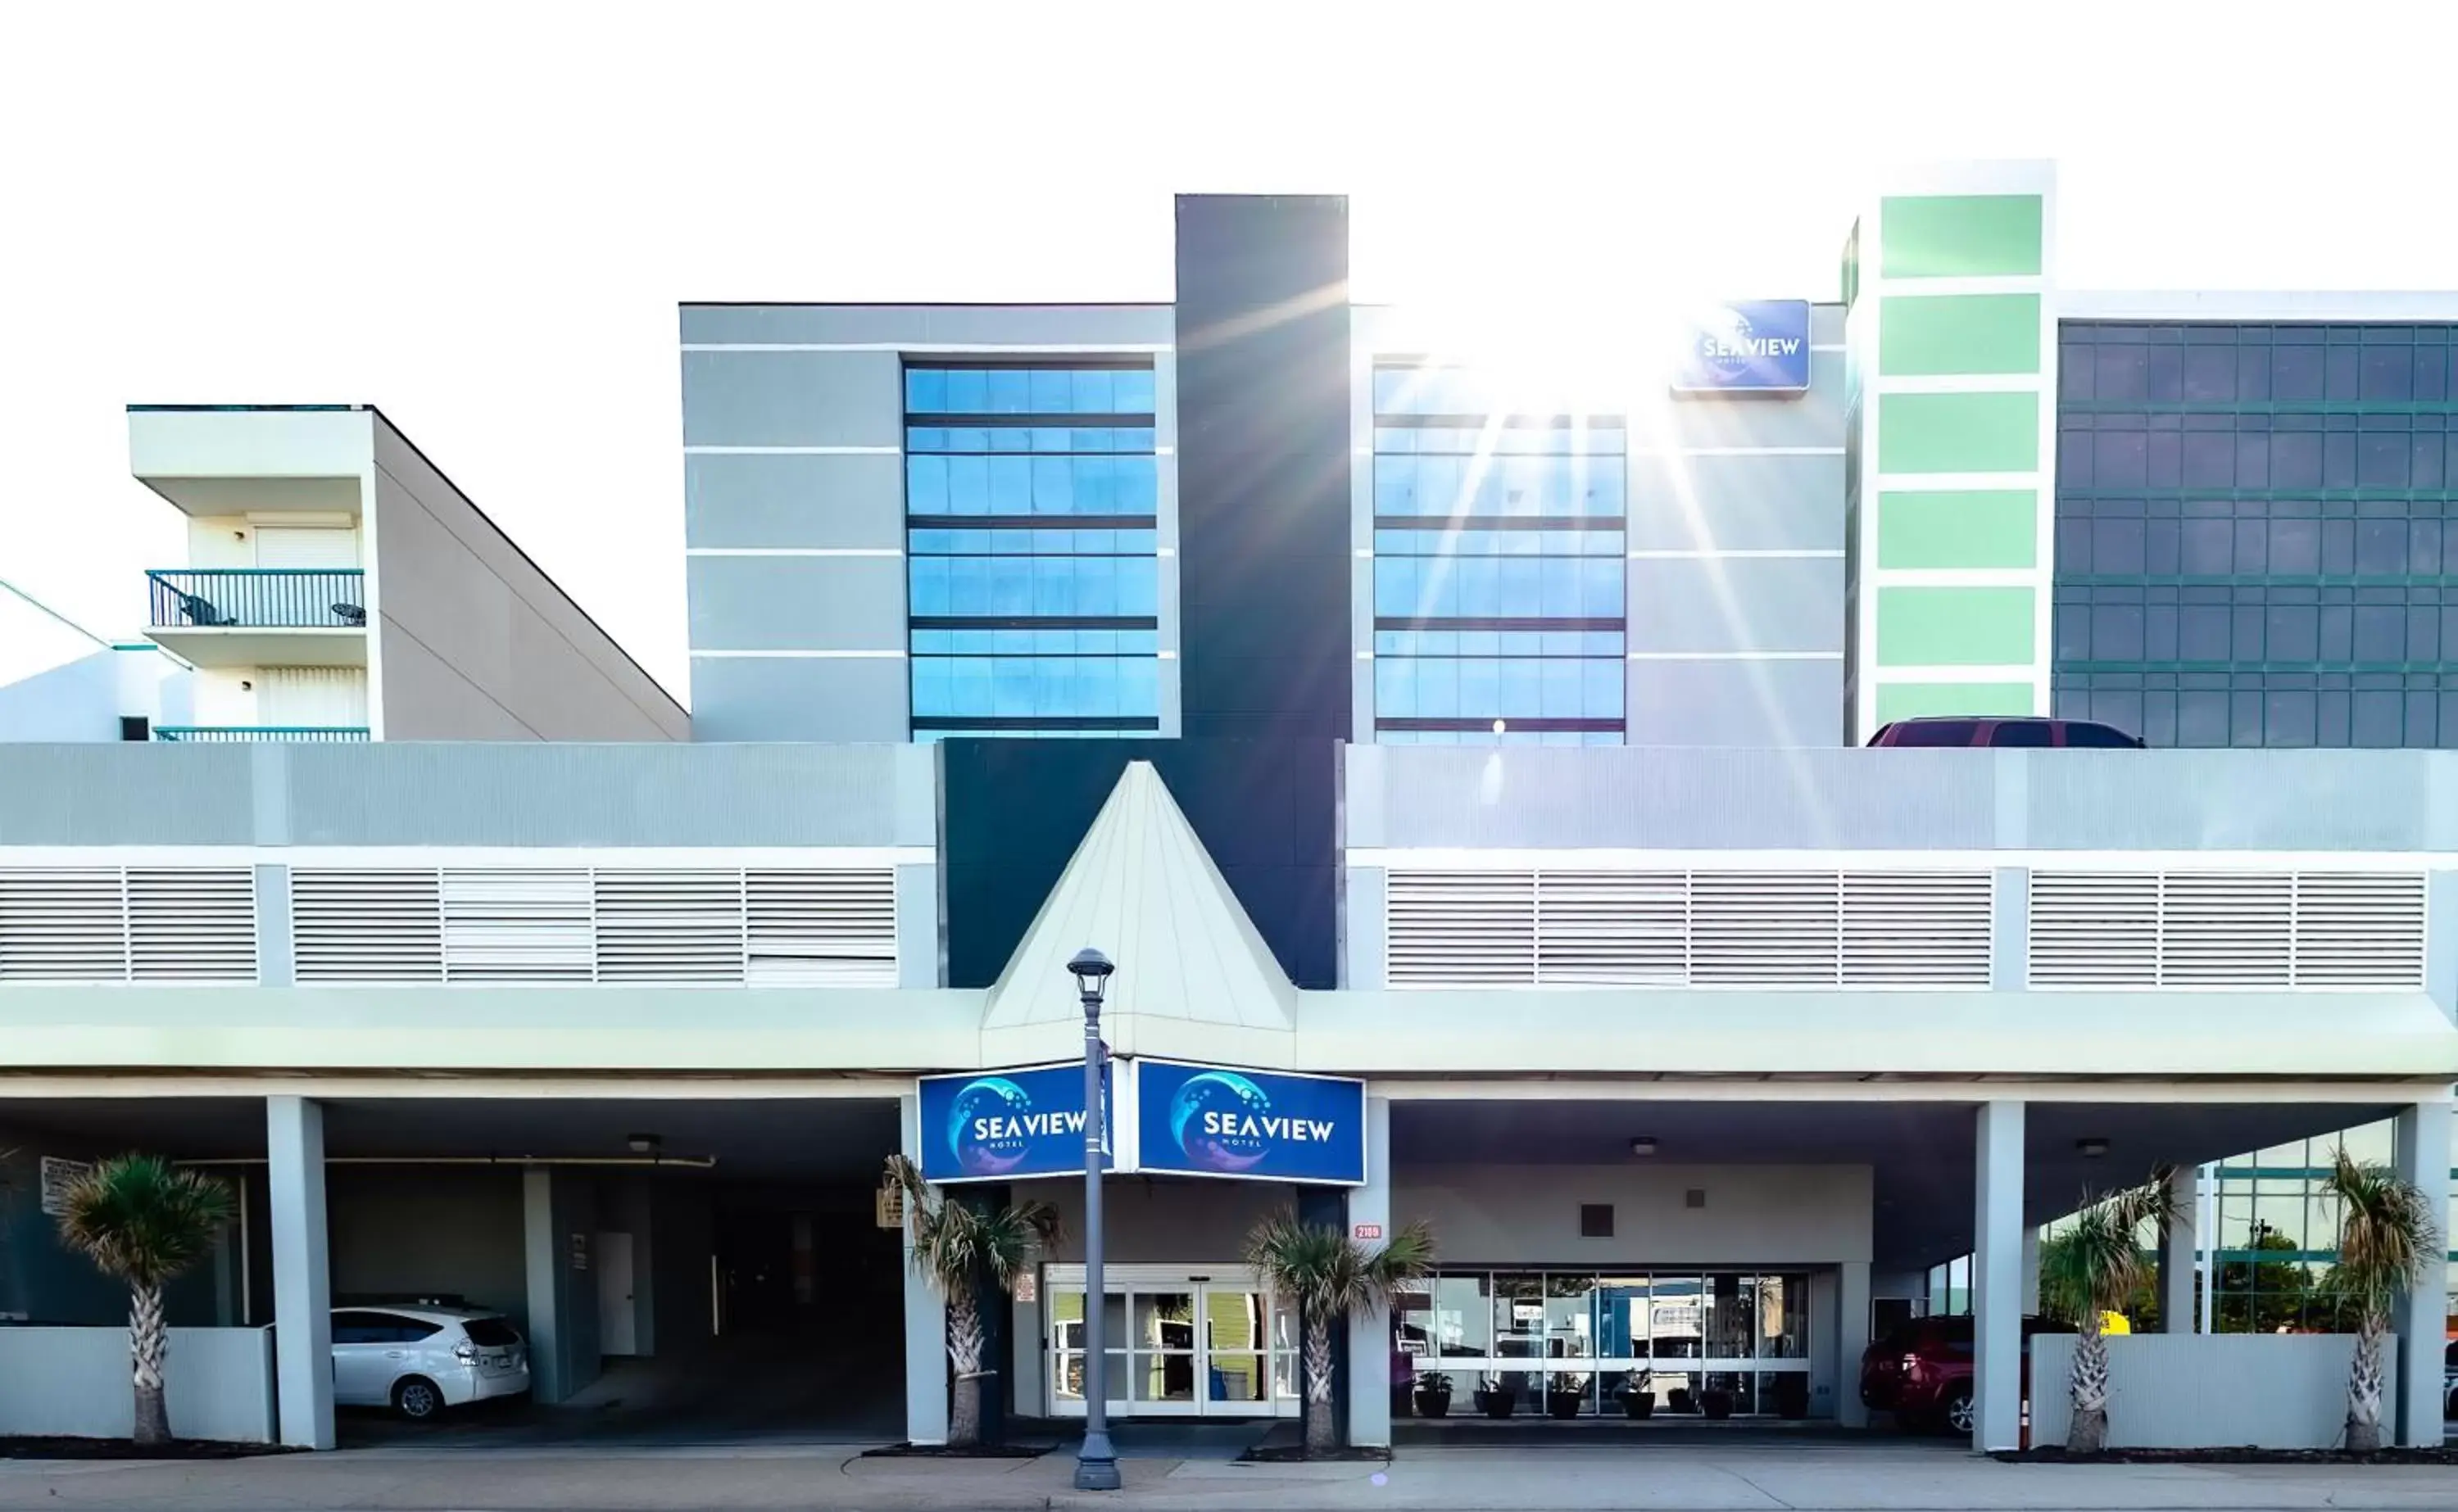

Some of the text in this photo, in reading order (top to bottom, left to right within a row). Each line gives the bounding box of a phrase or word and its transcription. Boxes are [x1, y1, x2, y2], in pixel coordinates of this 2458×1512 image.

[1703, 337, 1801, 357] SEAVIEW
[974, 1110, 1087, 1141] SEAVIEW
[1204, 1111, 1335, 1143] SEAVIEW
